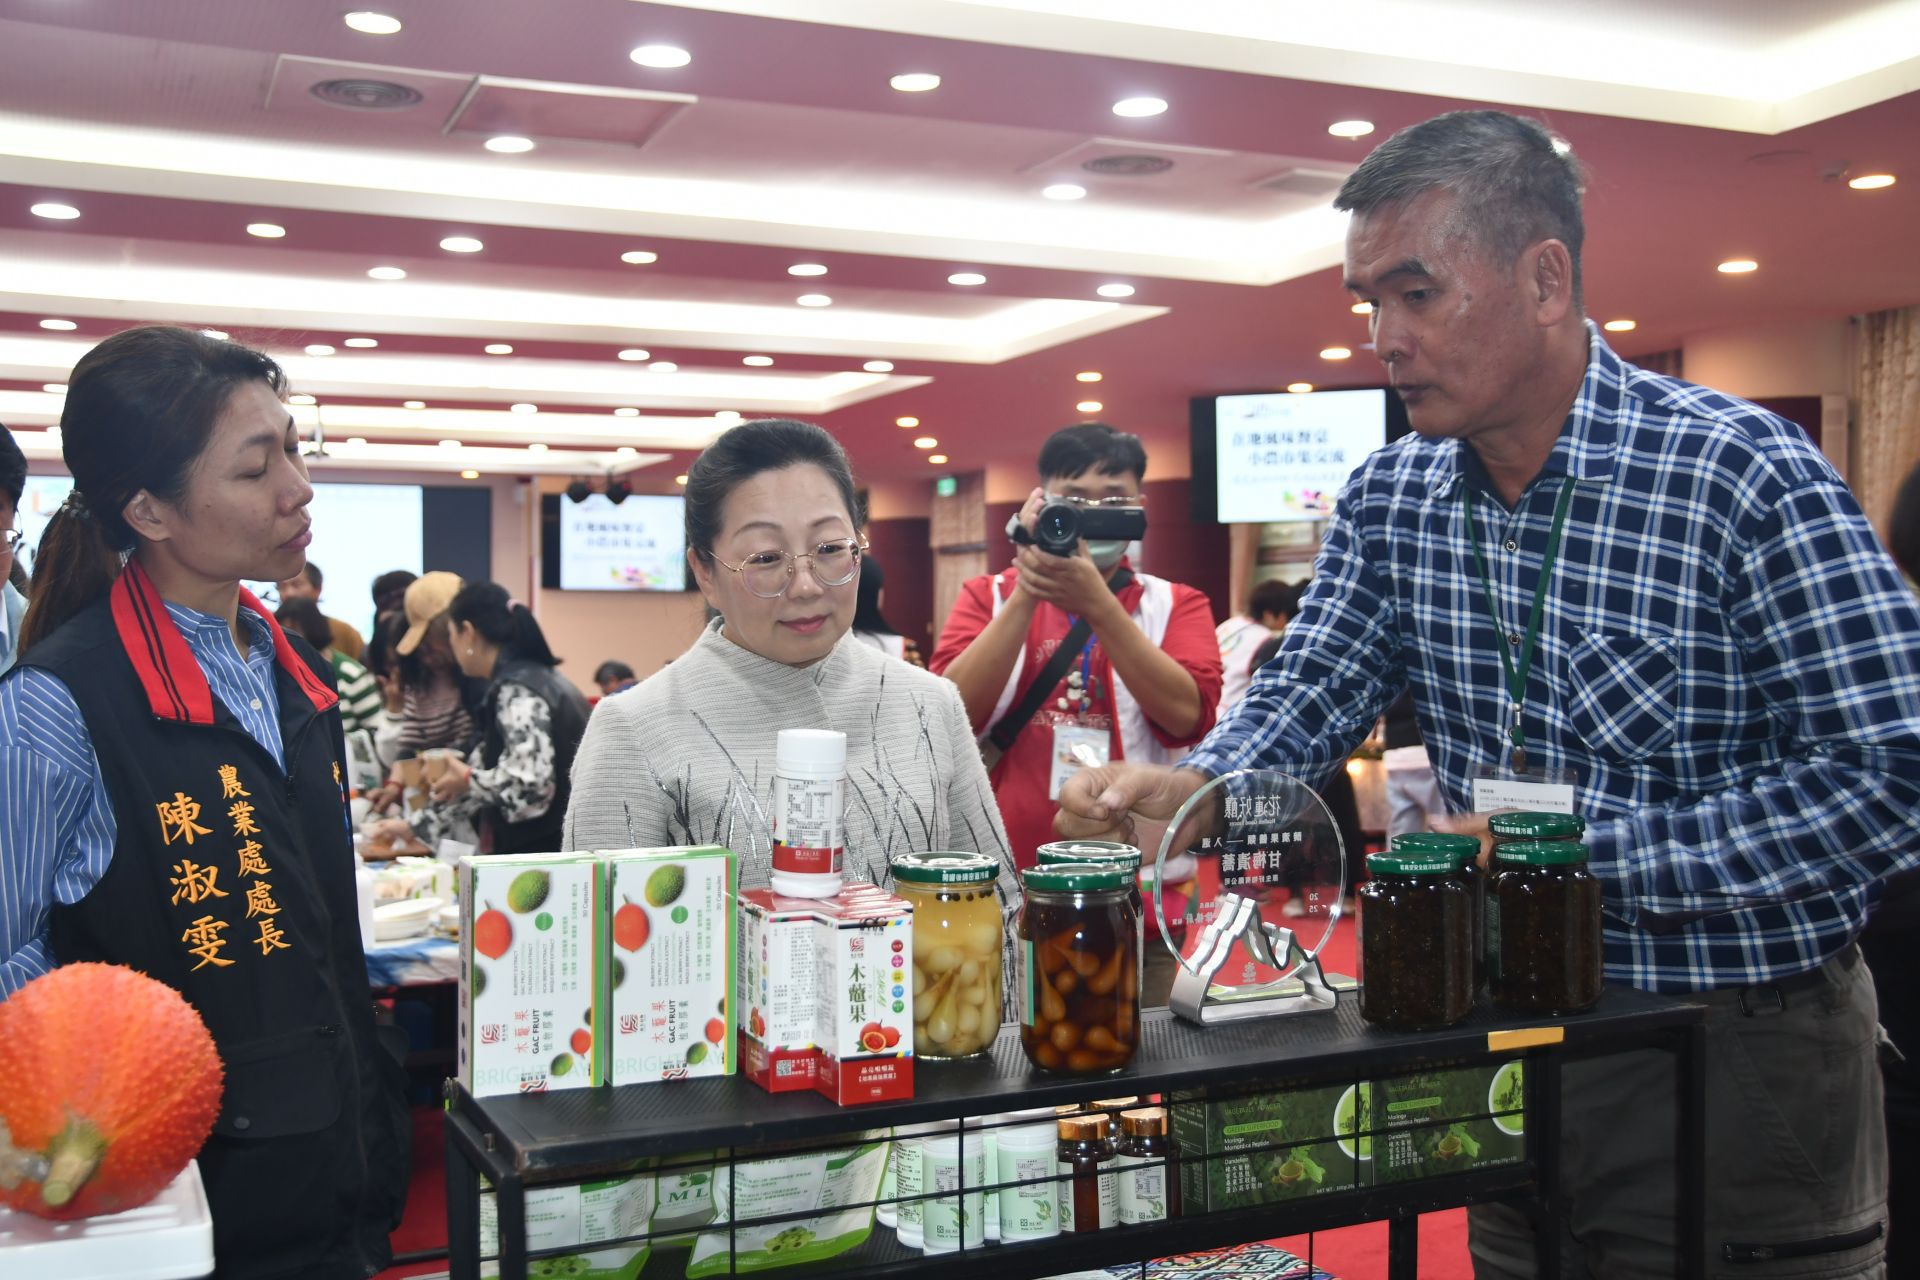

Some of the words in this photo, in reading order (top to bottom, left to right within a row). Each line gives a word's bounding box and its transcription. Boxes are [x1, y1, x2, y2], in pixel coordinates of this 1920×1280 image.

[217, 763, 292, 956] 農業處處長
[155, 791, 237, 973] 陳淑雯
[532, 1008, 540, 1034] FRUIT
[532, 1036, 540, 1055] GAC
[1224, 1137, 1244, 1145] Moringa
[1224, 1157, 1249, 1165] Dandelion
